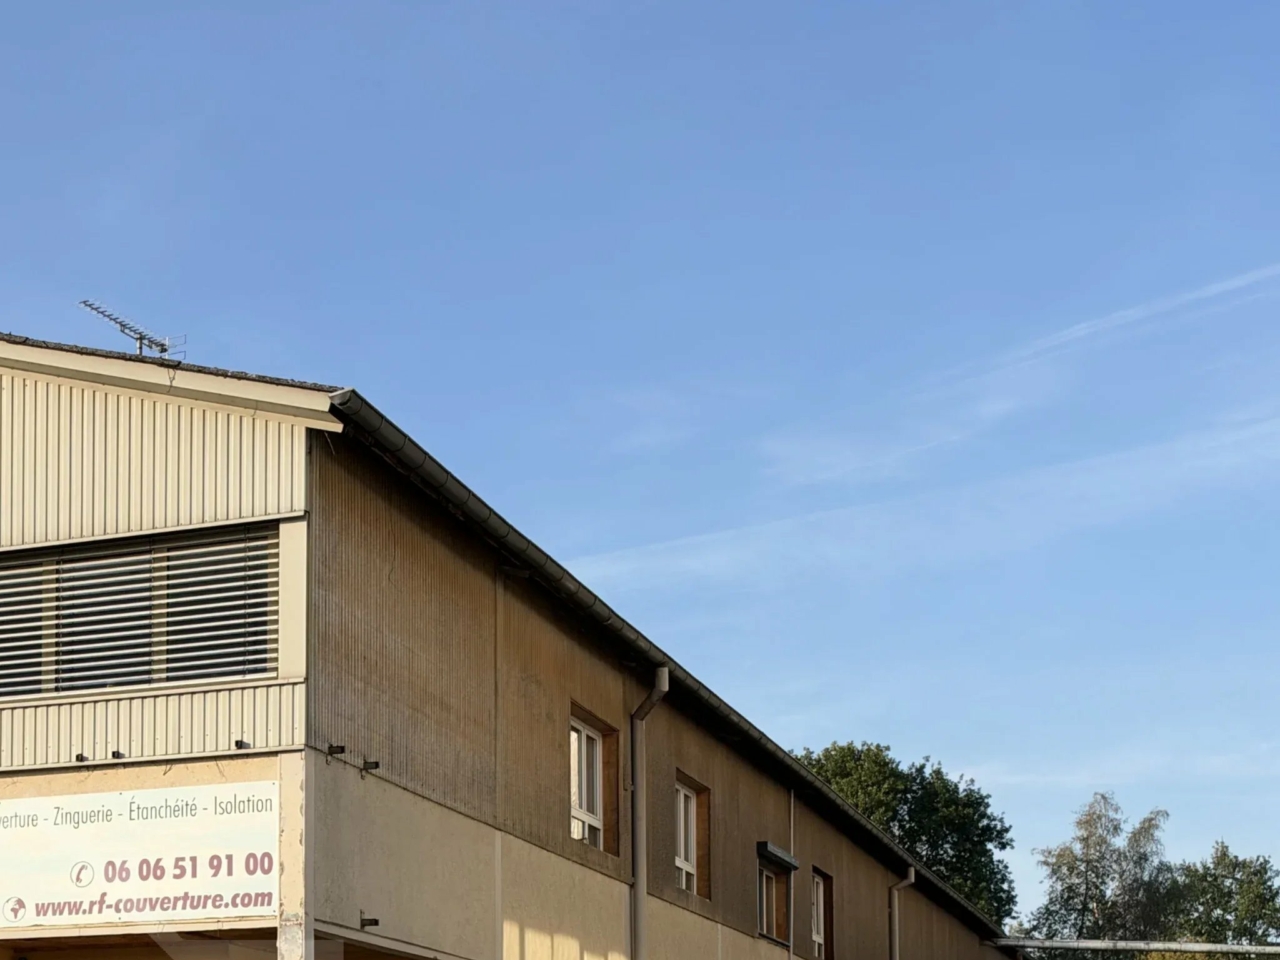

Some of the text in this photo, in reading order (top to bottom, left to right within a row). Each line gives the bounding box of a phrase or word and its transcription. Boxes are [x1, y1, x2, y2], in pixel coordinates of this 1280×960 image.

[53, 804, 113, 830] Zinguerie
[129, 795, 198, 821] Étanchéité
[214, 793, 273, 815] Isolation
[103, 851, 274, 883] 06 06 51 91 00
[34, 891, 274, 917] www.rf-couverture.com
